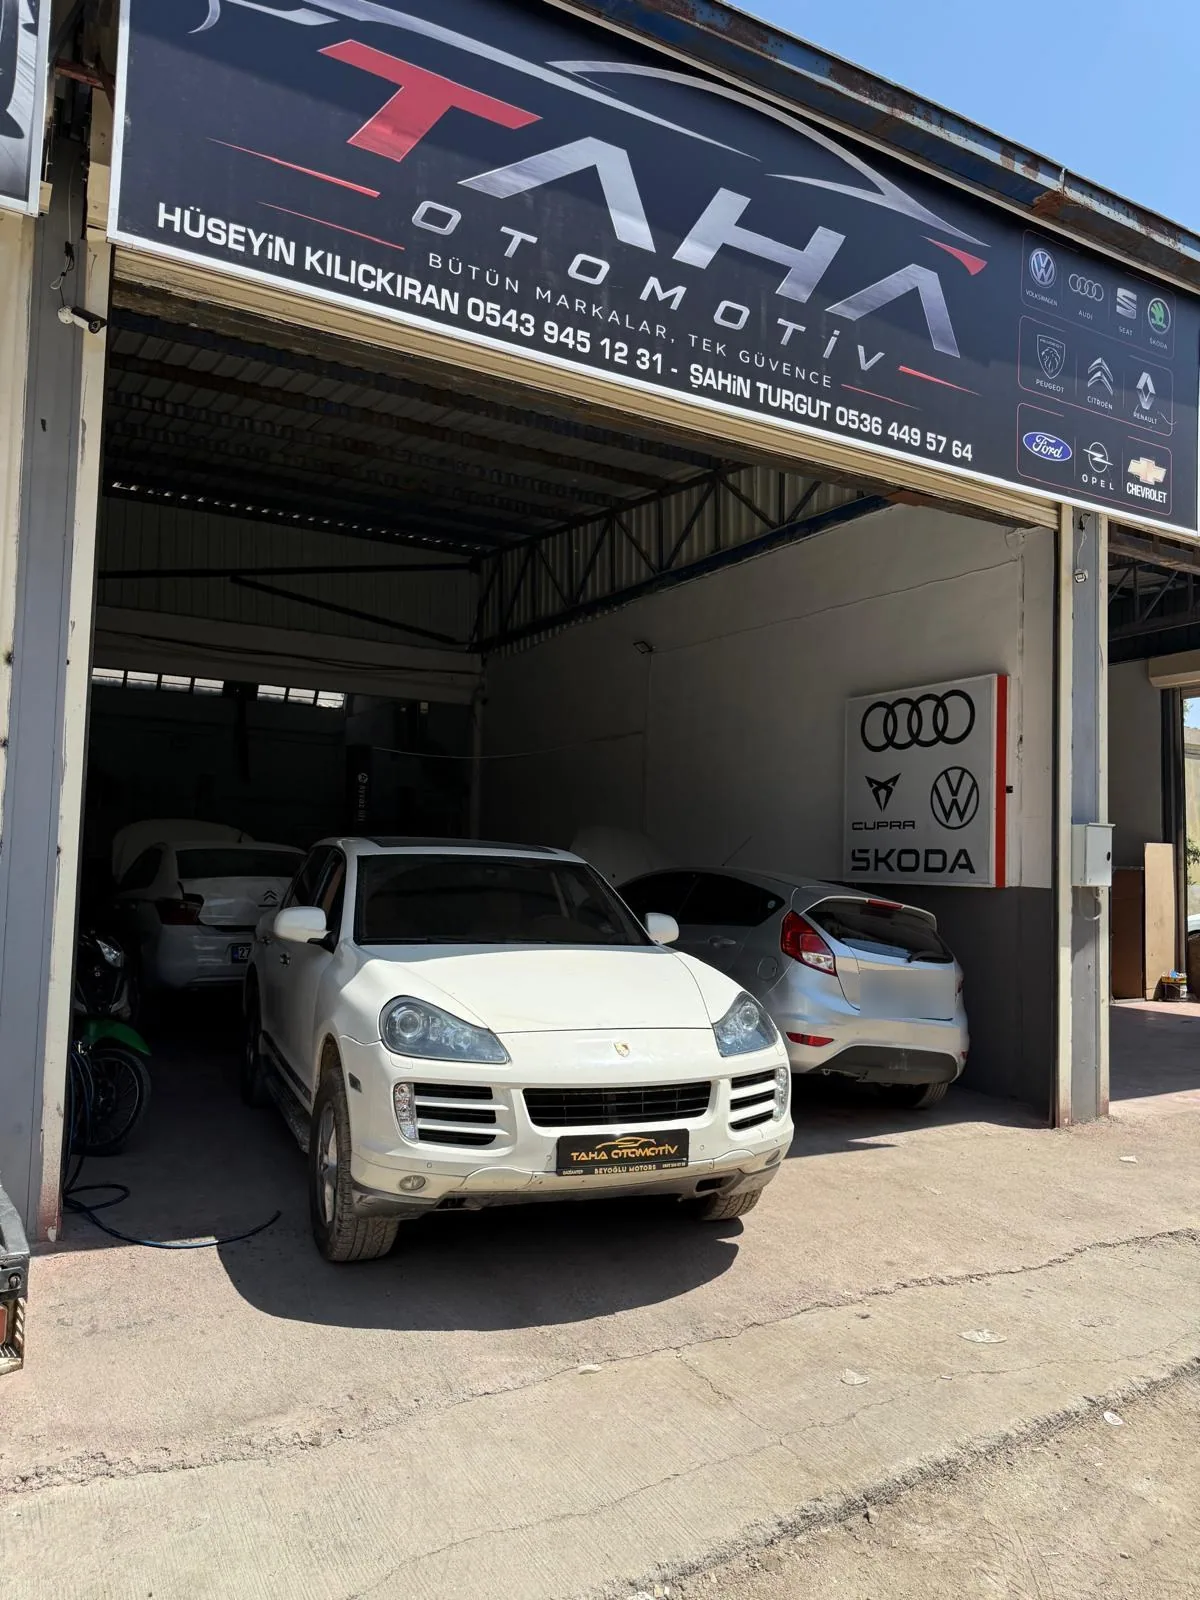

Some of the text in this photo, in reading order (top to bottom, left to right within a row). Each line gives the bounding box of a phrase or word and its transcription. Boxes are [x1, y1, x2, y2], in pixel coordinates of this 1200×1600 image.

[318, 39, 960, 359] TAHA
[429, 252, 832, 388] BÜTÜN MARKALAR, TEK GÜVENCE
[1119, 326, 1133, 336] SEAT
[305, 246, 460, 315] KILIÇKIRAN
[467, 297, 535, 337] 0543
[543, 320, 591, 353] 945
[600, 337, 629, 365] 12
[636, 347, 663, 375] 31
[756, 381, 831, 421] TURGUT
[835, 406, 882, 436] 0536
[888, 422, 921, 446] 449
[926, 431, 947, 453] 57
[952, 439, 973, 462] 64
[1035, 378, 1065, 393] PEUGEOT
[1133, 411, 1157, 425] RENAULT
[1032, 434, 1063, 459] Ford
[1081, 473, 1114, 491] OPEL
[1126, 482, 1167, 504] CHEVROLET
[852, 820, 915, 831] CUPRA
[570, 1151, 608, 1161] TAHA
[594, 1165, 627, 1174] BEYOĞLU
[628, 1164, 657, 1172] MOTORS
